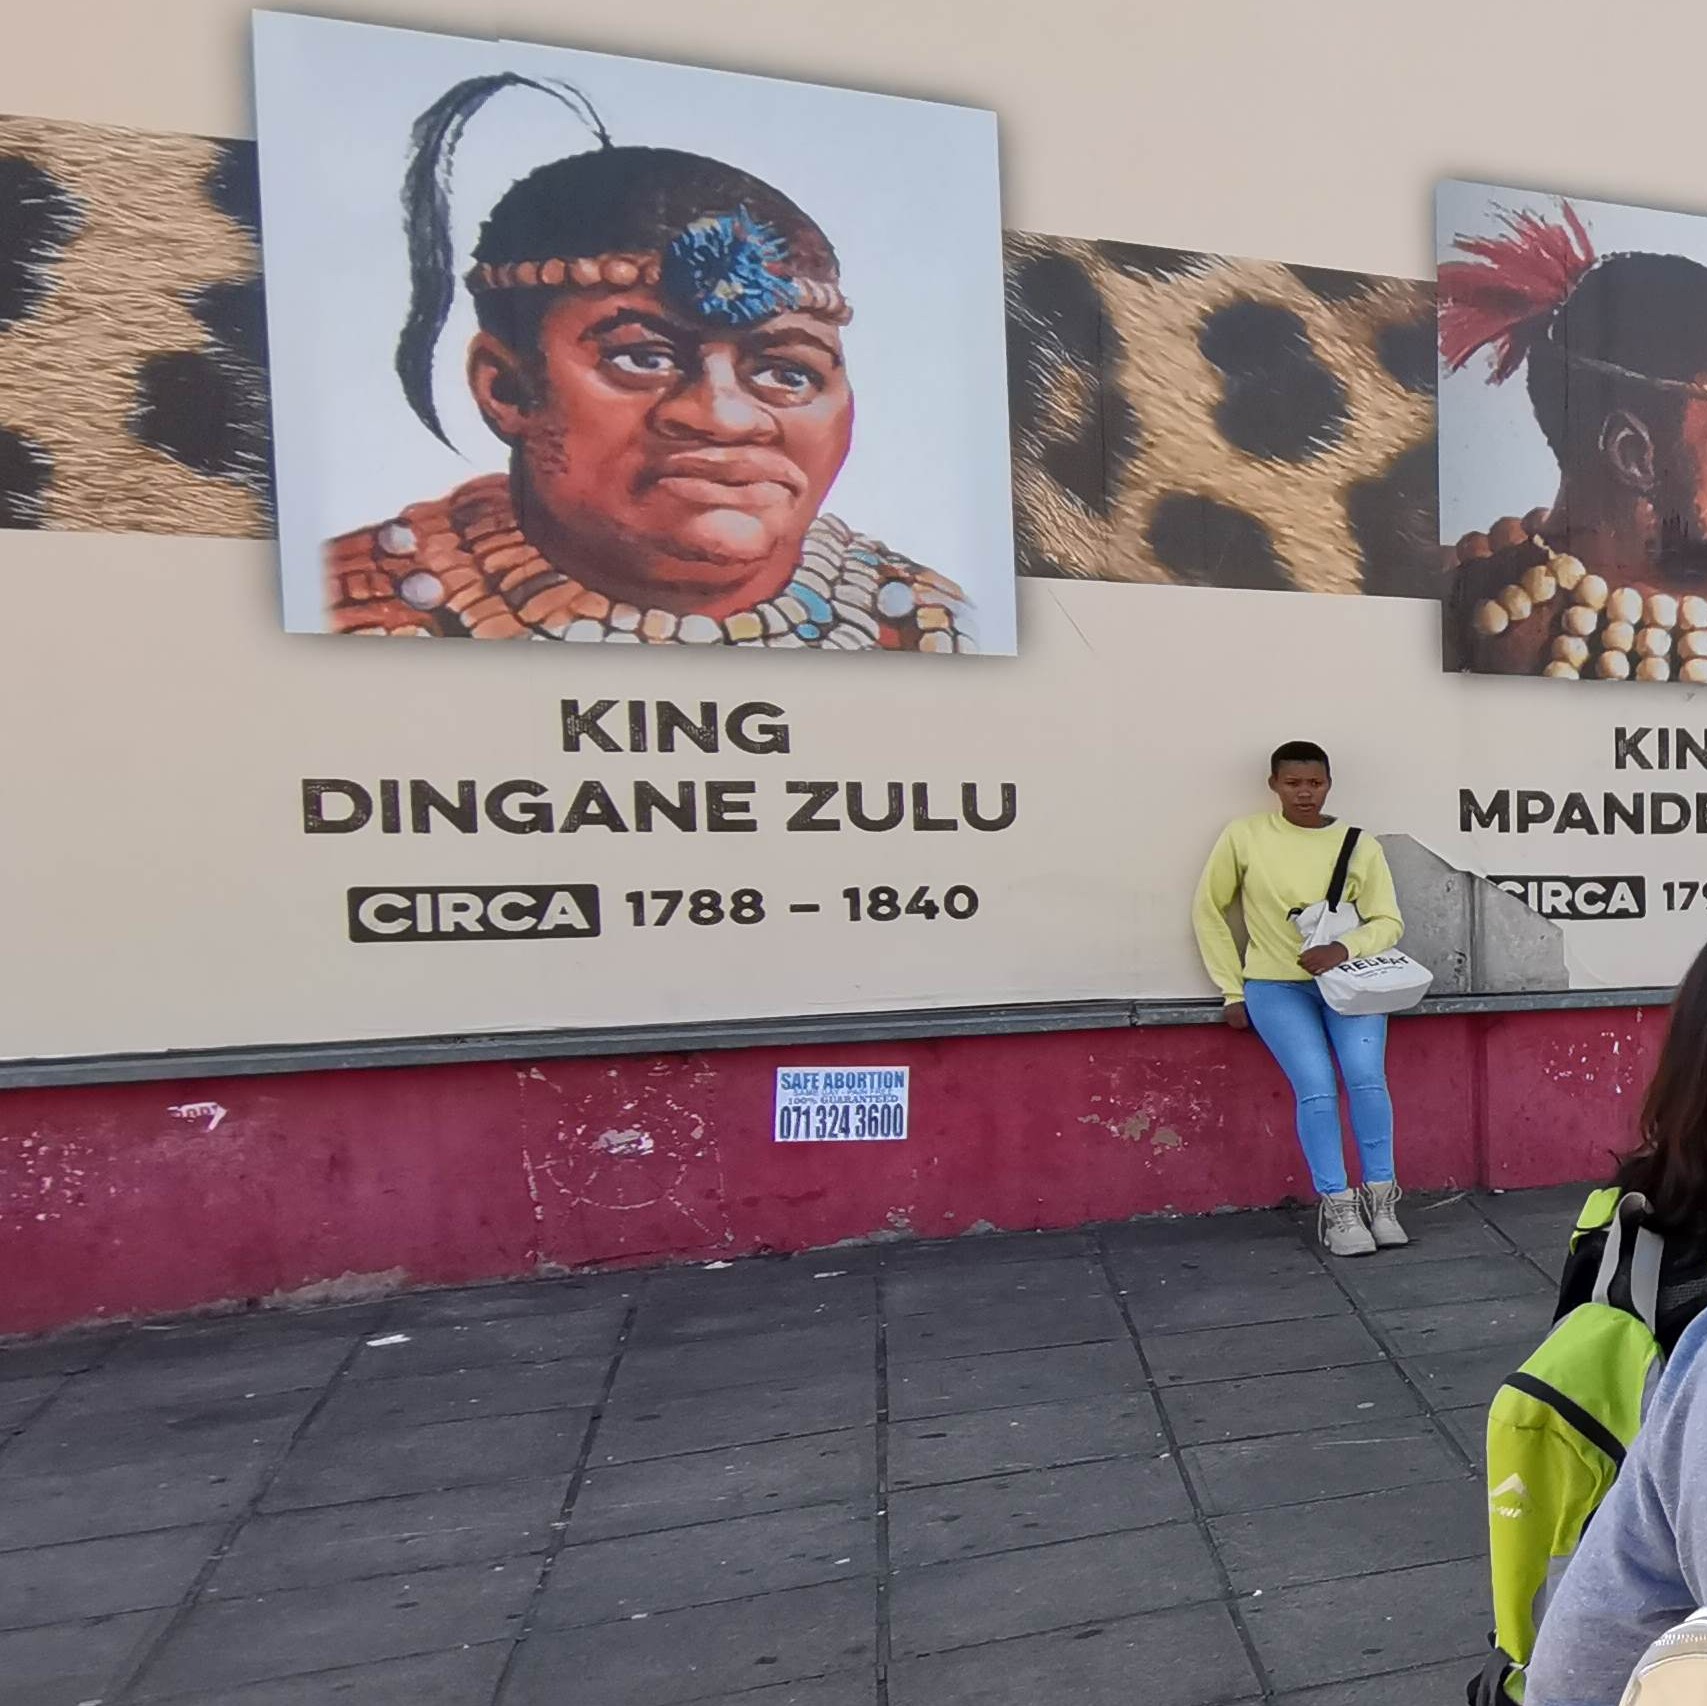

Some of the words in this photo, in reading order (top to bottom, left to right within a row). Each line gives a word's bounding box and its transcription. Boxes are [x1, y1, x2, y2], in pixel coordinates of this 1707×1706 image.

[561, 699, 790, 754] KING
[302, 779, 757, 834] DINGANE
[786, 781, 1016, 834] ZULU
[358, 891, 590, 935] CIRCA
[626, 889, 765, 926] 1788
[843, 885, 979, 922] 1840
[781, 1072, 820, 1090] SAFE
[823, 1071, 905, 1089] ABORTION
[780, 1105, 810, 1139] 071
[815, 1104, 850, 1138] 324
[854, 1102, 904, 1138] 3600
